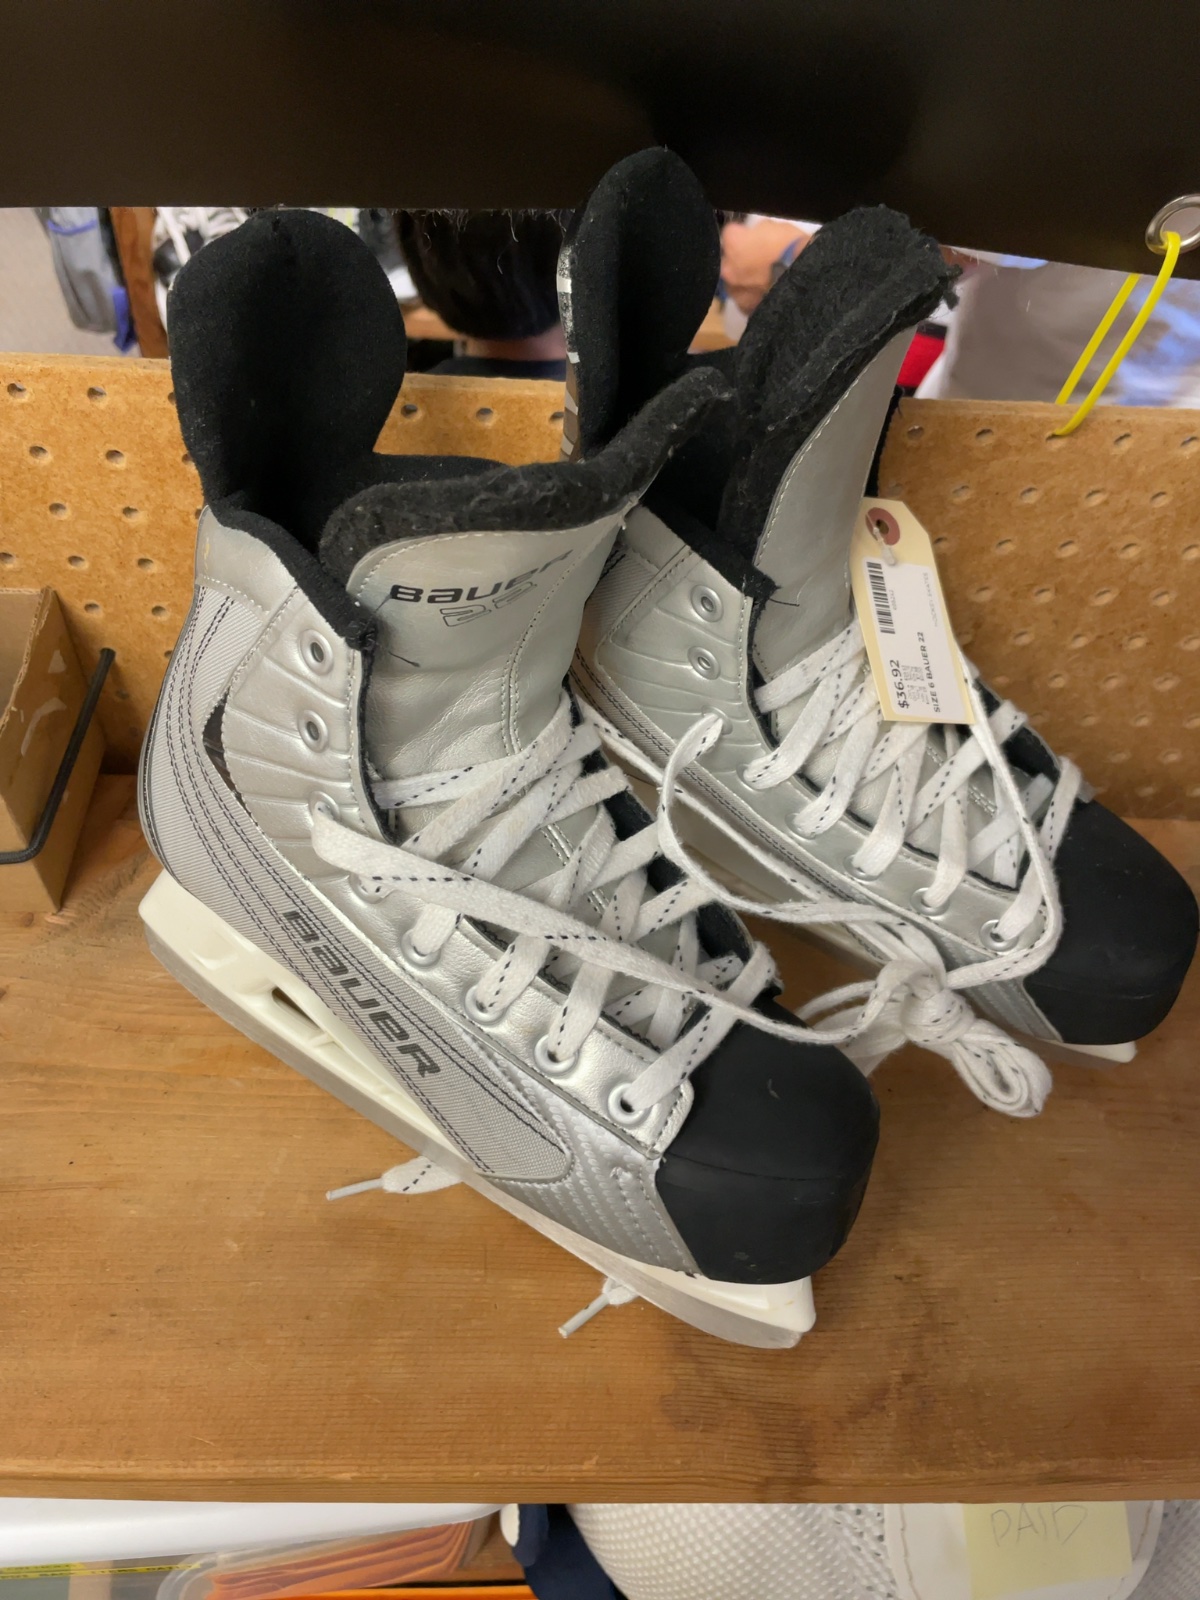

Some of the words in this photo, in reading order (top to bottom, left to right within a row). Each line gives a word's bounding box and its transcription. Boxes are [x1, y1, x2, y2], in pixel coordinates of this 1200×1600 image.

[917, 632, 924, 643] 22
[920, 645, 933, 680] BAUER
[889, 660, 910, 709] $36.92
[930, 691, 941, 713] SIZE
[990, 1502, 1089, 1548] PAID
